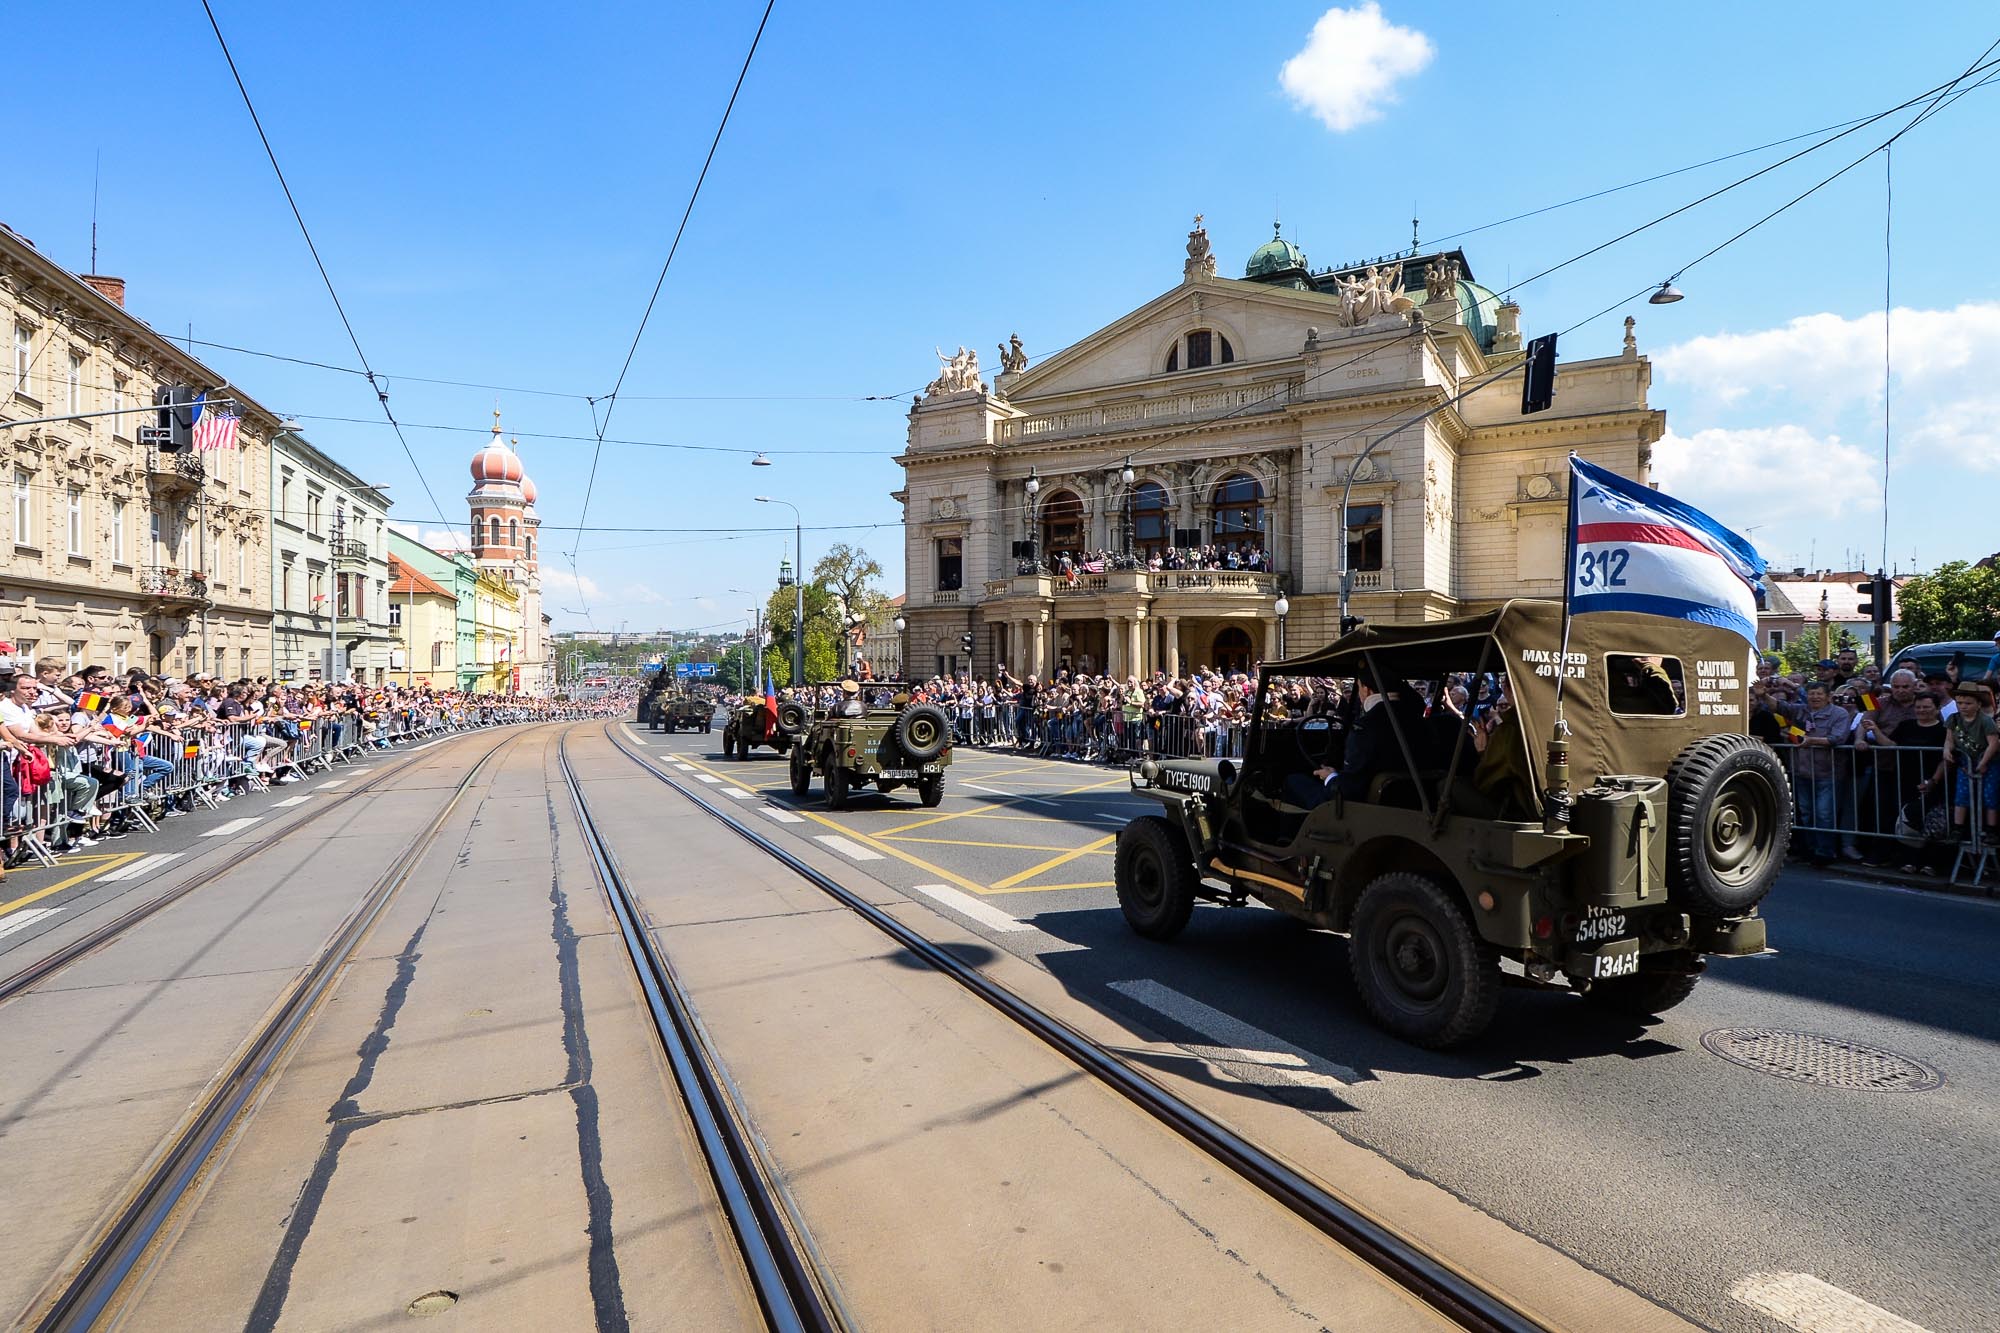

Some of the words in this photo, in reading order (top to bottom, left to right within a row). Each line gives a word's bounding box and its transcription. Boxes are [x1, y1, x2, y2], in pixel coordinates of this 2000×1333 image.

[1346, 367, 1380, 380] OPERA
[1579, 548, 1630, 587] 312
[1522, 649, 1551, 663] MAX
[1535, 664, 1552, 677] 40
[1696, 660, 1736, 677] CAUTION
[1697, 678, 1717, 690] LEFT
[1718, 678, 1740, 690] HAND
[1697, 691, 1723, 703] DRIVE
[1699, 703, 1711, 716] NO
[1712, 704, 1741, 716] SIGNAL
